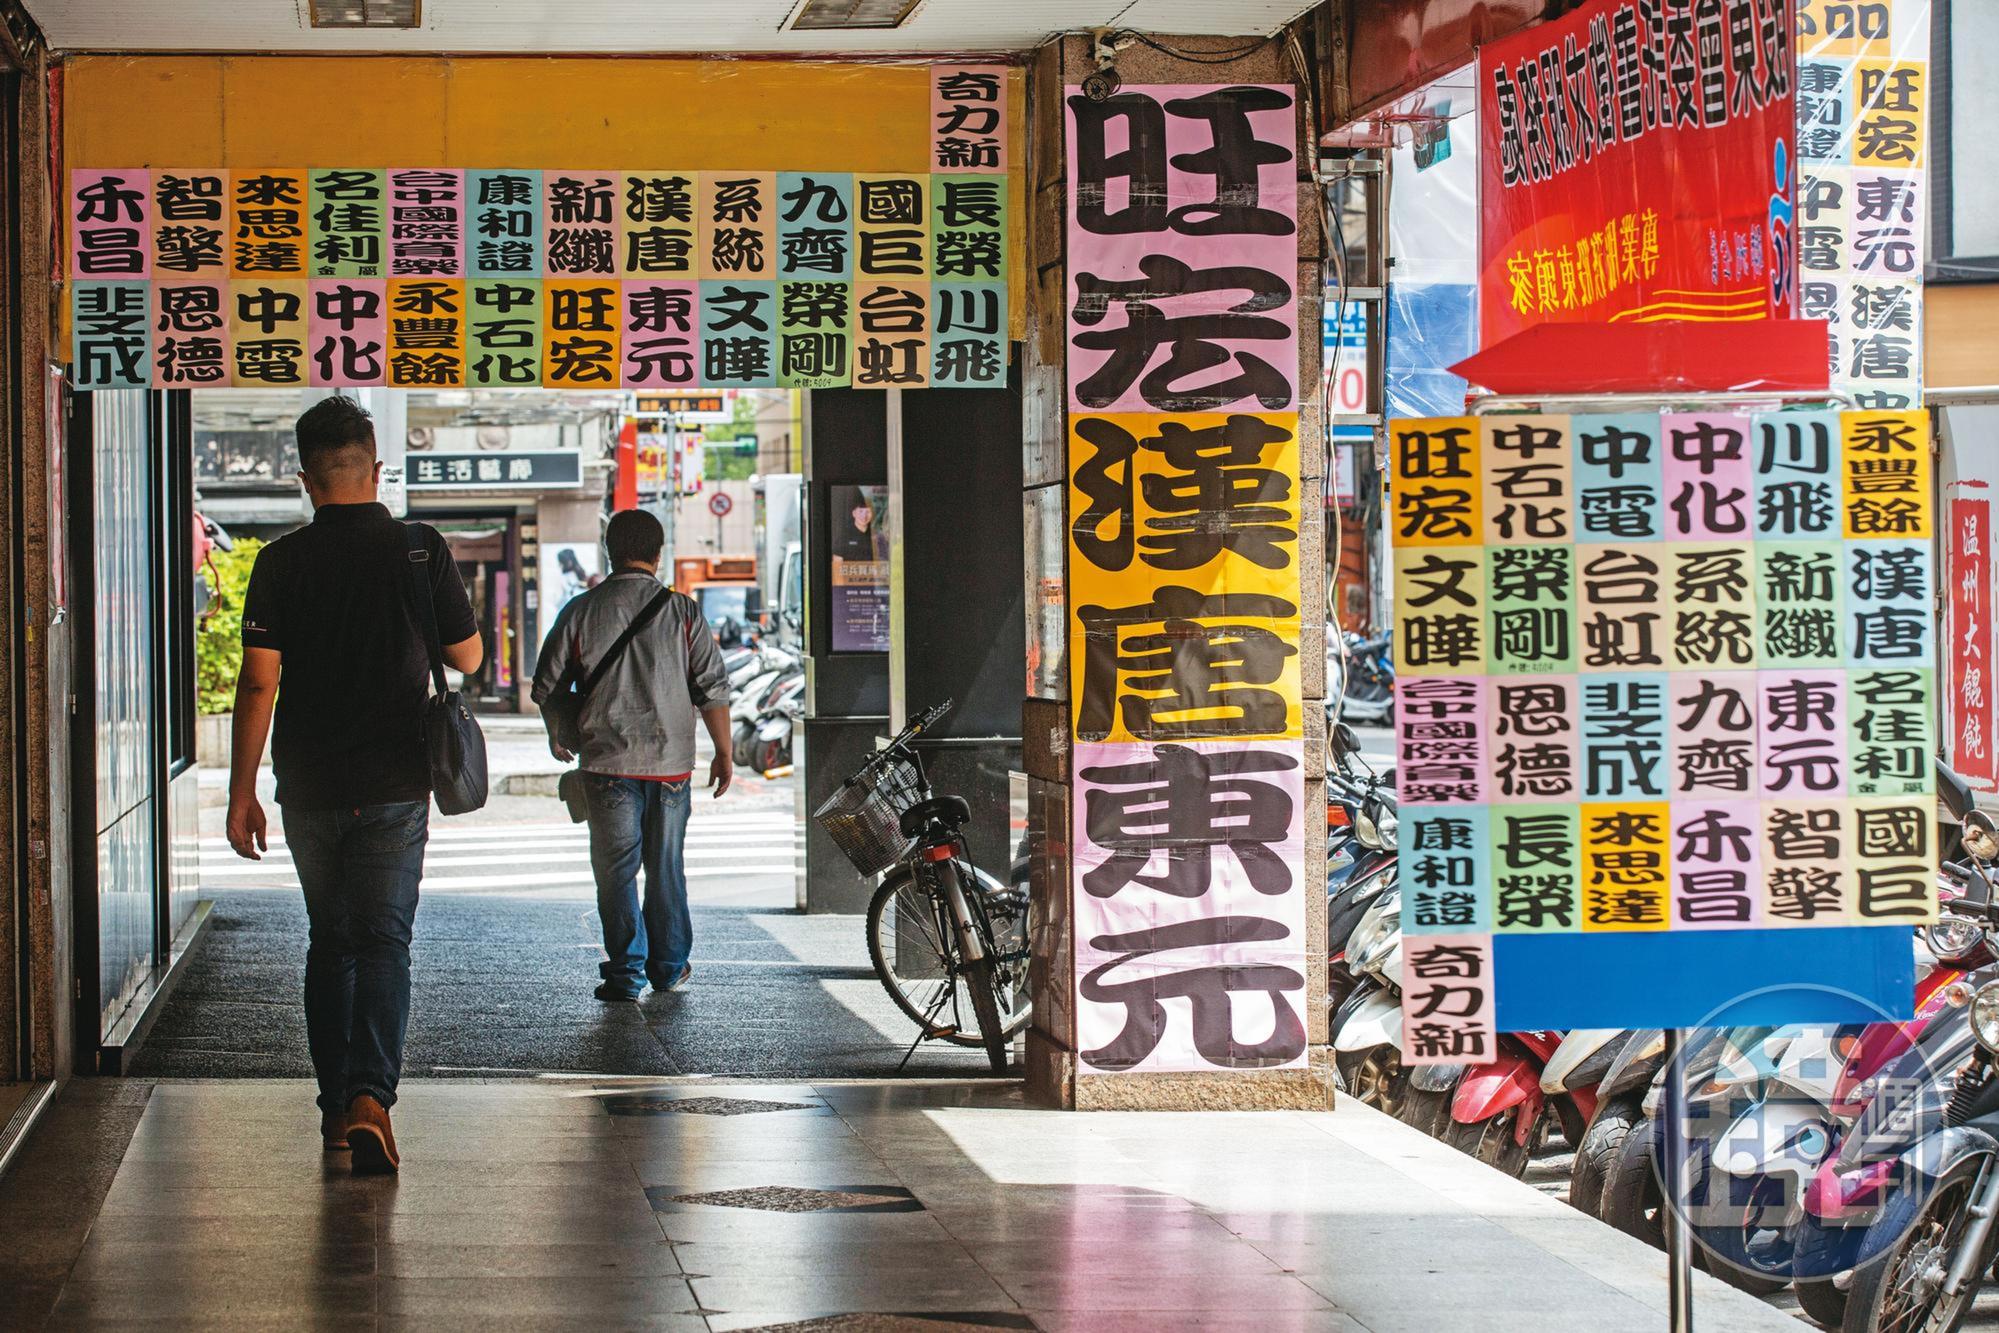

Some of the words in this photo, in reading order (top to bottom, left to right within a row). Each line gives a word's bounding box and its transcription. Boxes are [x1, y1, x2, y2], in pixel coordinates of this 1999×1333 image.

[937, 72, 1000, 167] 奇力新
[1859, 69, 1919, 161] 旺宏
[156, 175, 223, 272] 智擎
[236, 176, 301, 271] 來思達
[314, 172, 380, 264] 名佳利
[478, 175, 533, 271] 康和證
[549, 178, 614, 273] 新纖
[627, 177, 692, 271] 漢唐
[713, 179, 763, 272] 系統
[782, 178, 847, 273] 九齊
[859, 180, 924, 274] 國巨
[936, 182, 1001, 276] 長榮
[1067, 86, 1296, 411] 旺宏
[1854, 177, 1916, 272] 東元
[78, 287, 145, 384] 斐成
[157, 286, 224, 382] 恩德
[236, 288, 302, 382] 中電
[314, 285, 380, 380] 中化
[391, 283, 459, 384] 永豐餘
[472, 284, 535, 383] 中石化
[551, 288, 614, 381] 旺宏
[628, 287, 693, 382] 東元
[705, 286, 770, 381] 文曄
[782, 283, 848, 376] 榮剛
[858, 287, 925, 383] 台虹
[935, 290, 1000, 382] 川飛
[1851, 285, 1912, 378] 漢唐
[1399, 428, 1471, 537] 旺宏
[1493, 425, 1566, 538] 中石化
[1580, 426, 1655, 537] 中電
[1671, 423, 1745, 533] 中化
[1760, 423, 1832, 533] 川飛
[1850, 421, 1919, 532] 永豐餘
[1072, 414, 1298, 742] 漢唐
[1404, 556, 1479, 666] 文曄
[1493, 549, 1568, 660] 榮剛
[1584, 551, 1661, 666] 台虹
[1676, 549, 1752, 663] 系統
[1765, 552, 1836, 657] 新纖
[1853, 549, 1925, 658] 漢唐
[1496, 685, 1571, 795] 恩德
[1586, 683, 1661, 795] 斐成
[1679, 681, 1752, 791] 九齊
[1767, 680, 1838, 790] 東元
[1854, 673, 1924, 778] 名佳利
[1080, 744, 1308, 1071] 東元
[1414, 818, 1475, 925] 康和證
[1498, 815, 1573, 927] 長榮
[1591, 813, 1663, 923] 來思達
[1770, 809, 1841, 919] 智擎
[1857, 807, 1928, 917] 國巨
[1412, 946, 1484, 1056] 奇力新
